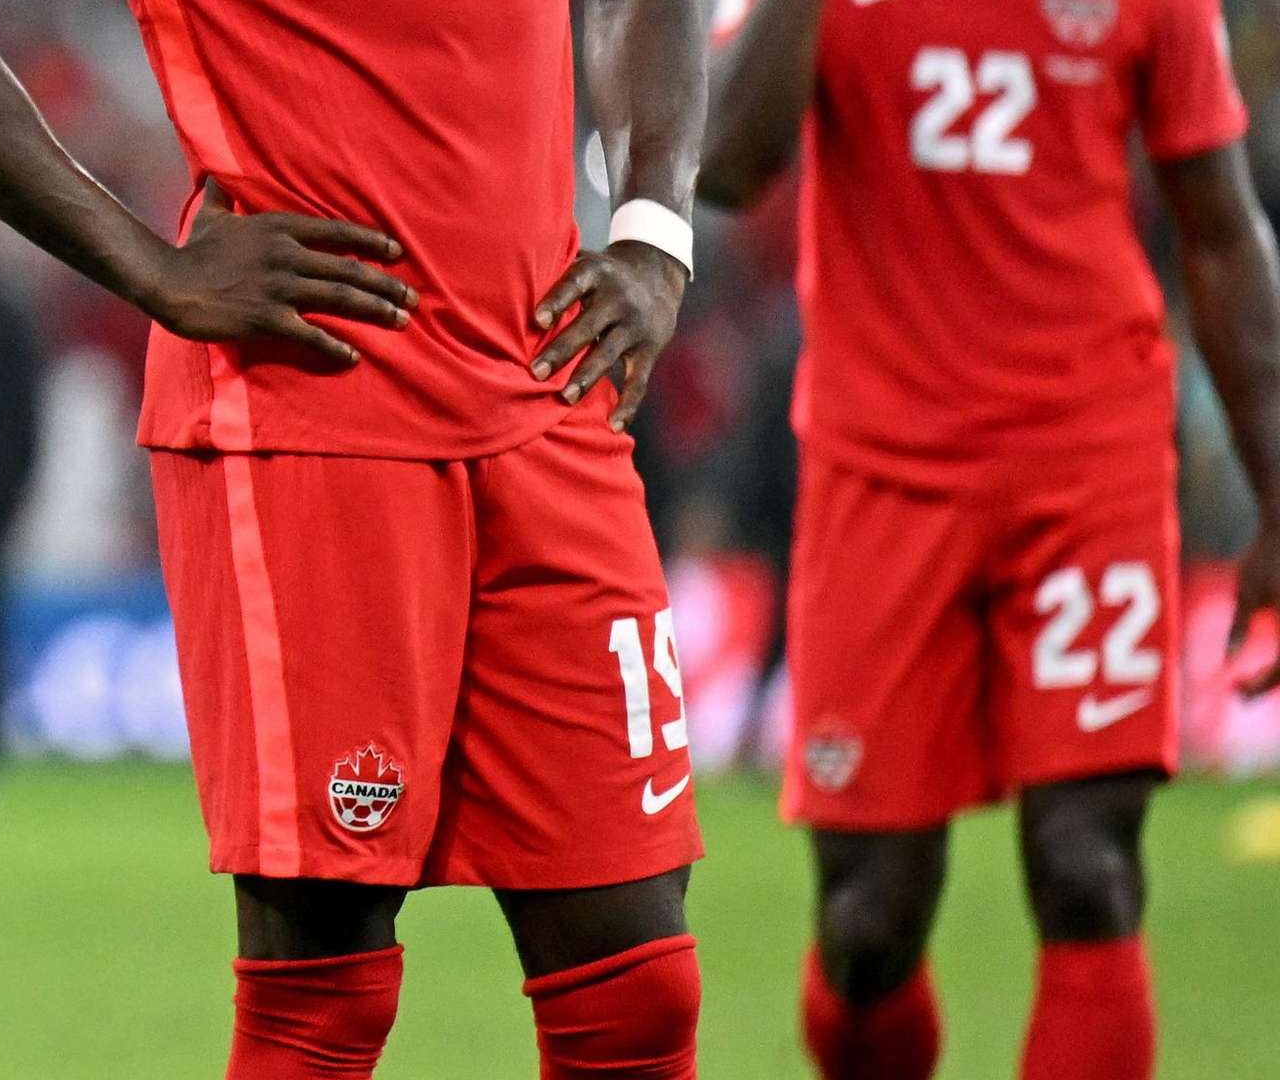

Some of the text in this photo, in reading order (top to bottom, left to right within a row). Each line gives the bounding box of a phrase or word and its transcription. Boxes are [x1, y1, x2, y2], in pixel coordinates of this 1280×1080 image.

[910, 46, 1037, 175] 22
[609, 607, 689, 759] 19
[1033, 561, 1162, 689] 22
[332, 782, 397, 798] CANADA
